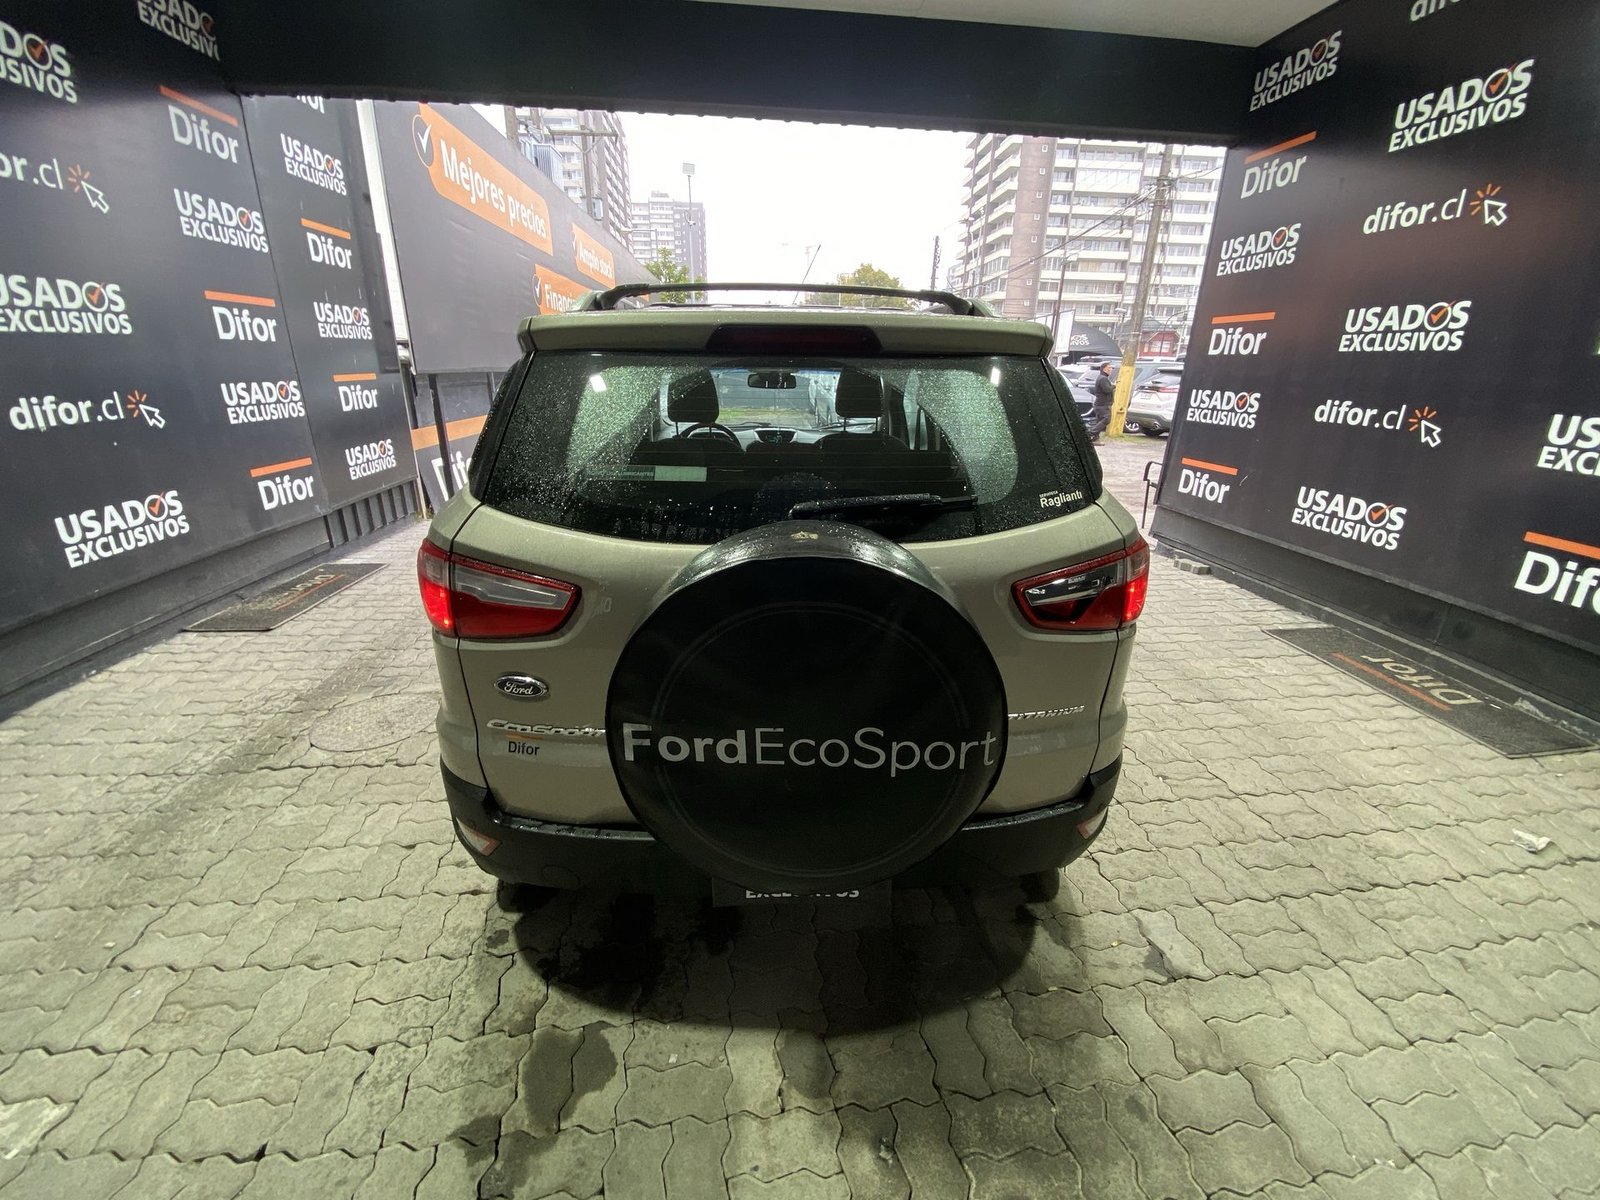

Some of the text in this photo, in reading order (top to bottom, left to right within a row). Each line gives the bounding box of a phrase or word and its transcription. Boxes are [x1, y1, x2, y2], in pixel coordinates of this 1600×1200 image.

[138, 1, 220, 61] EXCLUSIV
[144, 0, 216, 41] SADO
[0, 20, 71, 77] DOS
[1254, 30, 1342, 93] USADOS
[1250, 57, 1338, 112] EXCLUSIVOS
[1394, 59, 1534, 129] USADOS
[168, 104, 239, 163] Difor
[1388, 93, 1528, 153] EXCLUSIVOS
[0, 153, 63, 190] or.cl
[280, 133, 344, 180] USADOS
[284, 157, 347, 196] EXCLUSIVOS
[440, 138, 548, 239] Mejores precios
[1240, 155, 1308, 199] Difor
[173, 188, 264, 235] USADOS
[1363, 189, 1467, 235] difor.cl
[179, 216, 269, 254] EXCLUSIVOS
[306, 232, 352, 270] Difor
[1220, 223, 1302, 260] USADOS
[1216, 248, 1297, 276] EXCLUSIVOS
[212, 306, 277, 342] Difor
[313, 301, 370, 326] USADOS
[317, 322, 373, 340] EXCLUSIVOS
[1344, 300, 1472, 333] USADOS
[1208, 327, 1267, 355] Difor
[1338, 330, 1465, 352] EXCLUSIVOS
[9, 391, 125, 432] difor.cl
[220, 379, 301, 407] USADOS
[338, 385, 378, 412] Difor
[1190, 389, 1261, 413] USADOS
[227, 401, 305, 425] EXCLUSIVOS
[1186, 408, 1257, 429] EXCLUSIVOS
[1314, 400, 1407, 430] difor.cl
[345, 438, 394, 467] USADOS
[349, 455, 396, 481] EXCLUSIVOS
[257, 475, 314, 511] Difor
[1040, 490, 1083, 508] Raglianti
[1178, 468, 1230, 504] Difor
[54, 490, 183, 545] USADOS
[1297, 486, 1408, 531] USADOS
[64, 514, 190, 568] EXCLUSIVOS
[1291, 508, 1400, 550] EXCLUSIVOS
[1514, 550, 1600, 616] Dif
[504, 681, 534, 696] Ford
[508, 741, 540, 755] Difor
[622, 722, 997, 777] FordEcoSport
